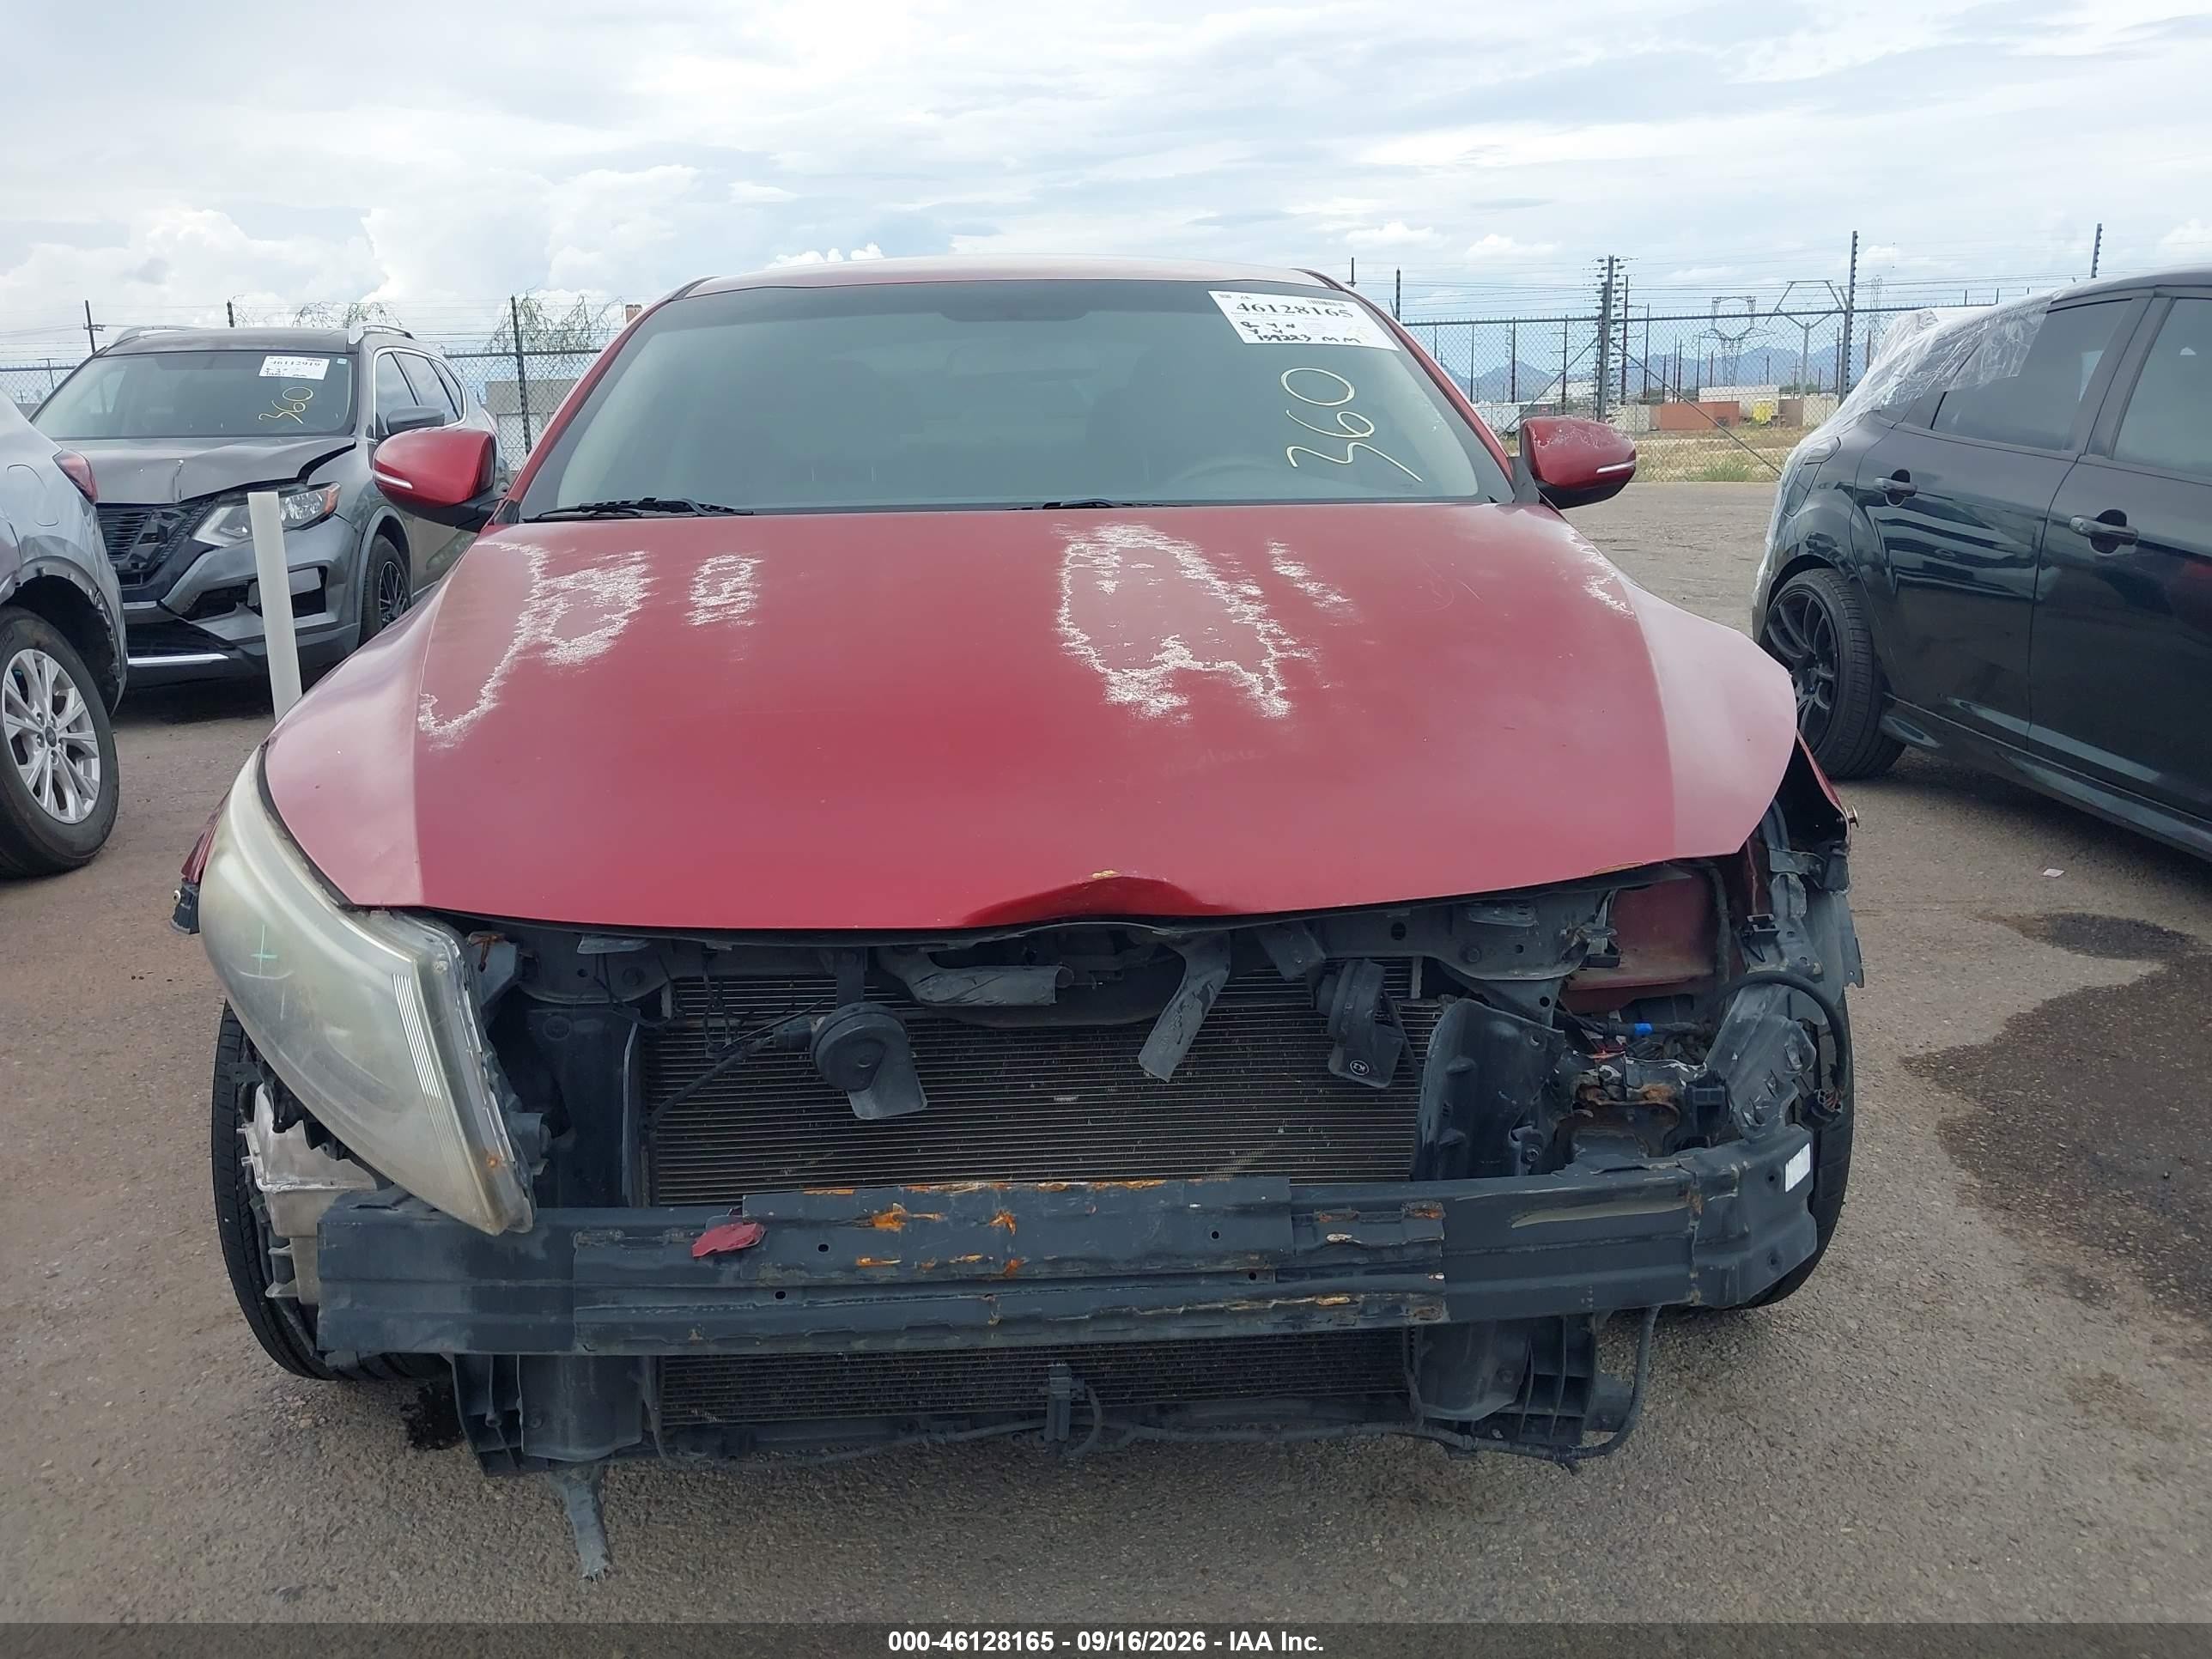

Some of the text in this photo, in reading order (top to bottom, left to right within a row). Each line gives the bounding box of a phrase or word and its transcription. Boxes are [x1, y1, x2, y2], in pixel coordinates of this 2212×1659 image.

[1236, 301, 1354, 319] 46128165
[258, 386, 313, 424] 360
[1280, 368, 1424, 483] 360
